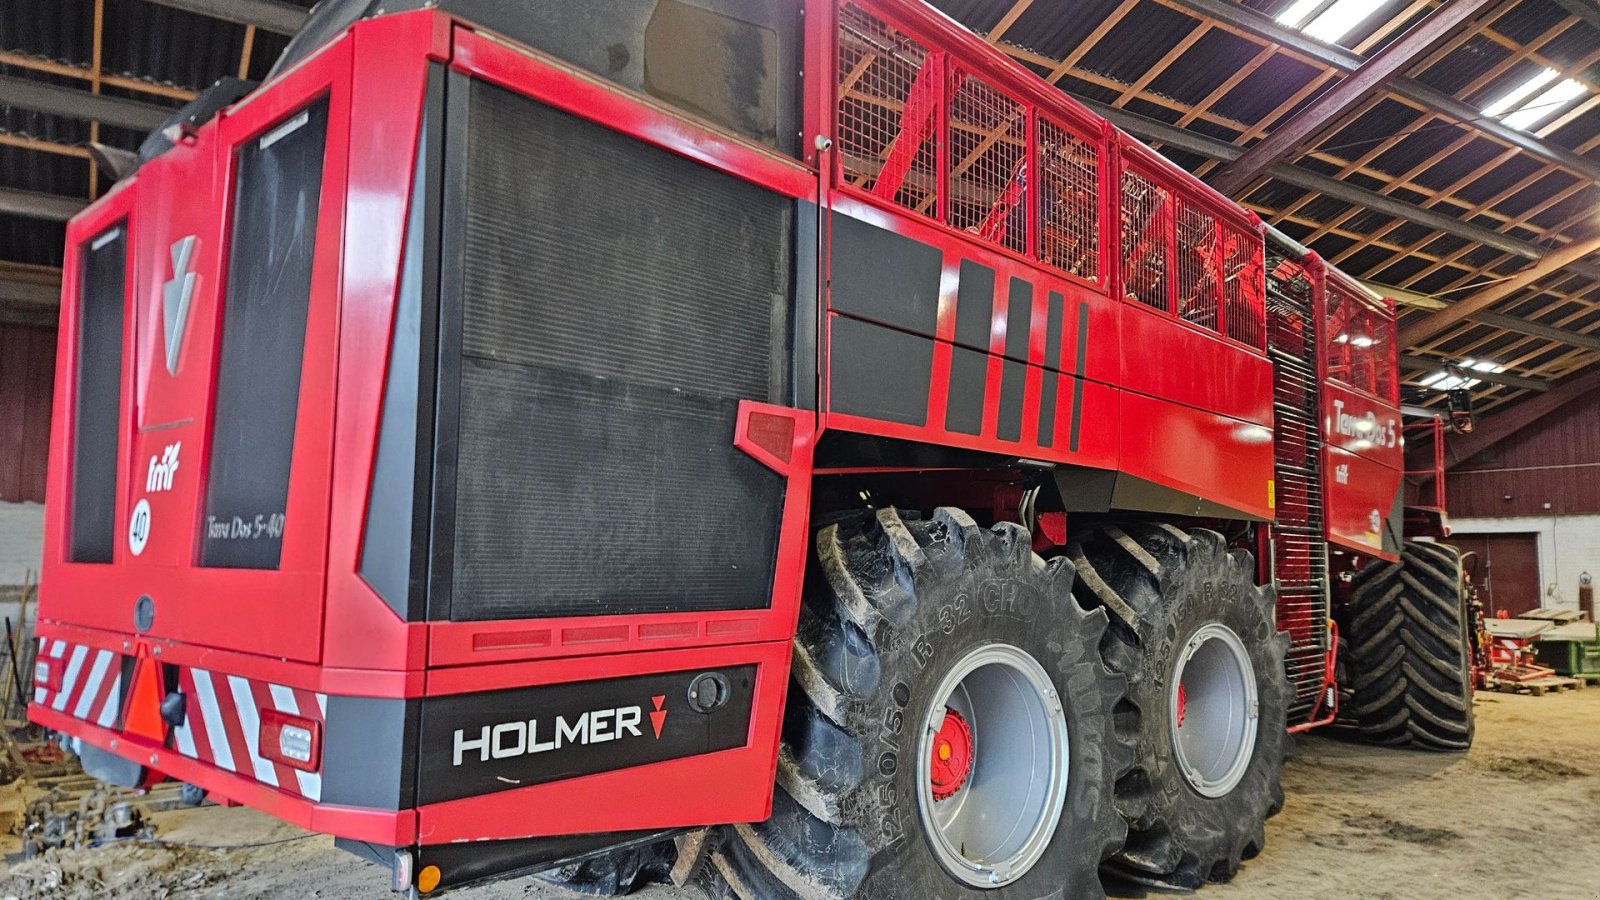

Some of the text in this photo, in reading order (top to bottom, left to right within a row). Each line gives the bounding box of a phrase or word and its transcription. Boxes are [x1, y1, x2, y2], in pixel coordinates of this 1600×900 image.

[1387, 418, 1396, 449] 5
[132, 511, 147, 543] 40
[252, 513, 286, 539] 5-40
[911, 633, 934, 670] R
[938, 593, 974, 635] 32
[452, 705, 643, 767] HOLMER
